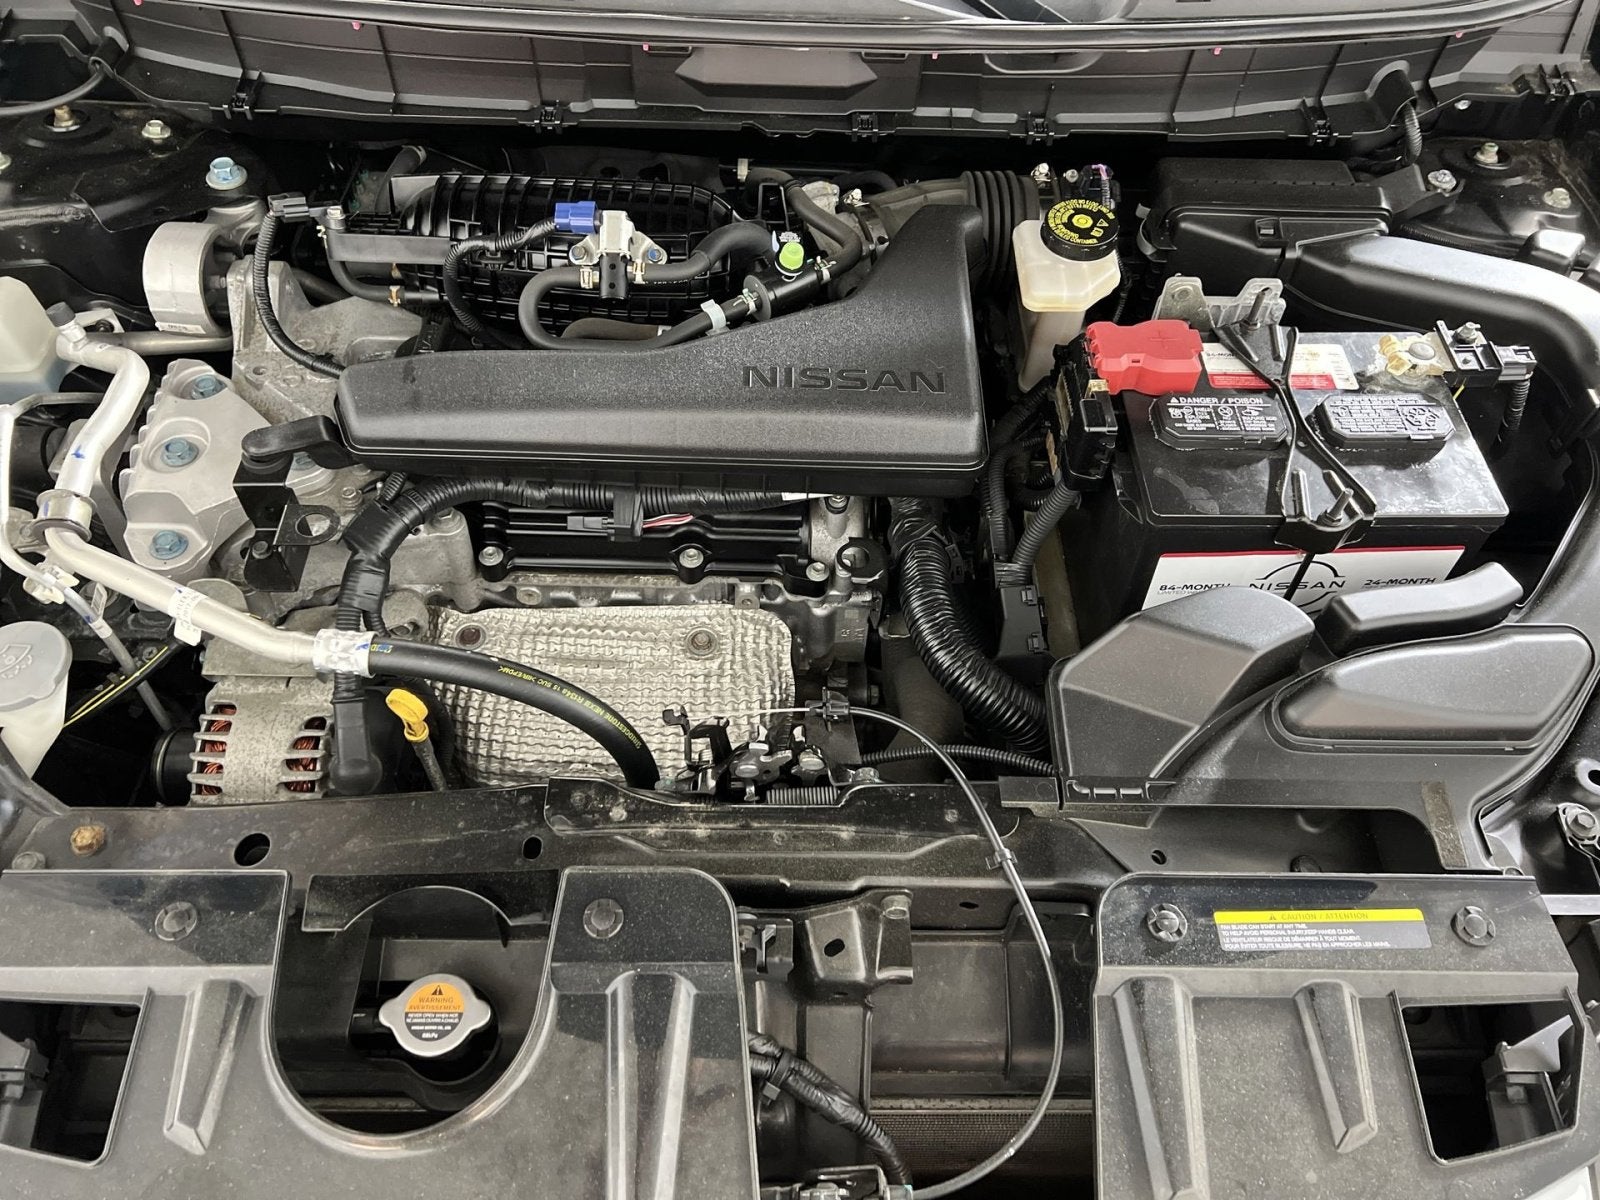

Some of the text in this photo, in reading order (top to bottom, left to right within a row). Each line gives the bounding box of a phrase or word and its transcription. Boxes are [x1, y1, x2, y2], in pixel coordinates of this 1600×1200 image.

[743, 366, 945, 394] NISSAN
[1249, 580, 1346, 590] NISSAN
[1363, 578, 1437, 586] 24-MONTH
